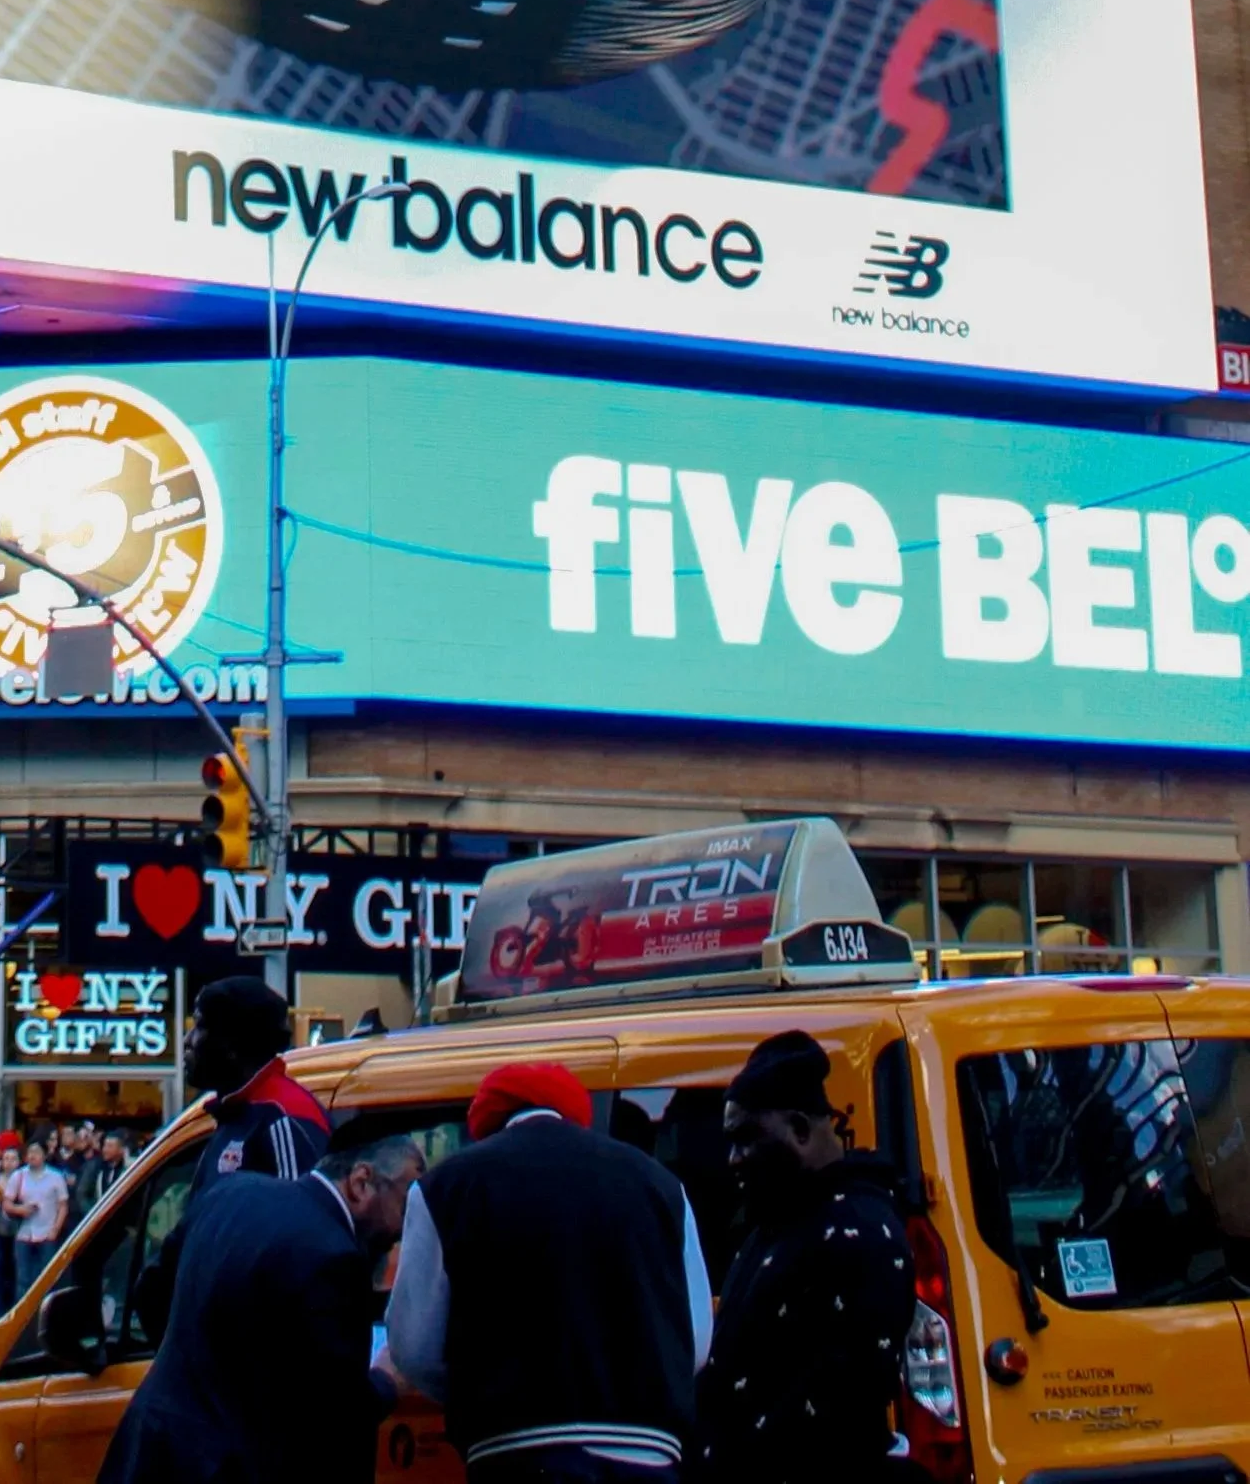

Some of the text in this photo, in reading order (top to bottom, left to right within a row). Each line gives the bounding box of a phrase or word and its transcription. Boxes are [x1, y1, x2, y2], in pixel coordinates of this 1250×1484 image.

[171, 148, 764, 289] new balance
[832, 305, 970, 338] new balance
[531, 455, 904, 655] five
[706, 835, 755, 856] IMAX
[622, 852, 773, 909] TRON
[95, 863, 131, 937] I
[634, 898, 740, 930] ARES
[823, 925, 869, 961] 6J34
[14, 970, 38, 1012] I
[14, 1017, 168, 1057] GIFTS
[1044, 1383, 1154, 1400] PASSENGER EXITING
[1066, 1368, 1115, 1381] CAUTION
